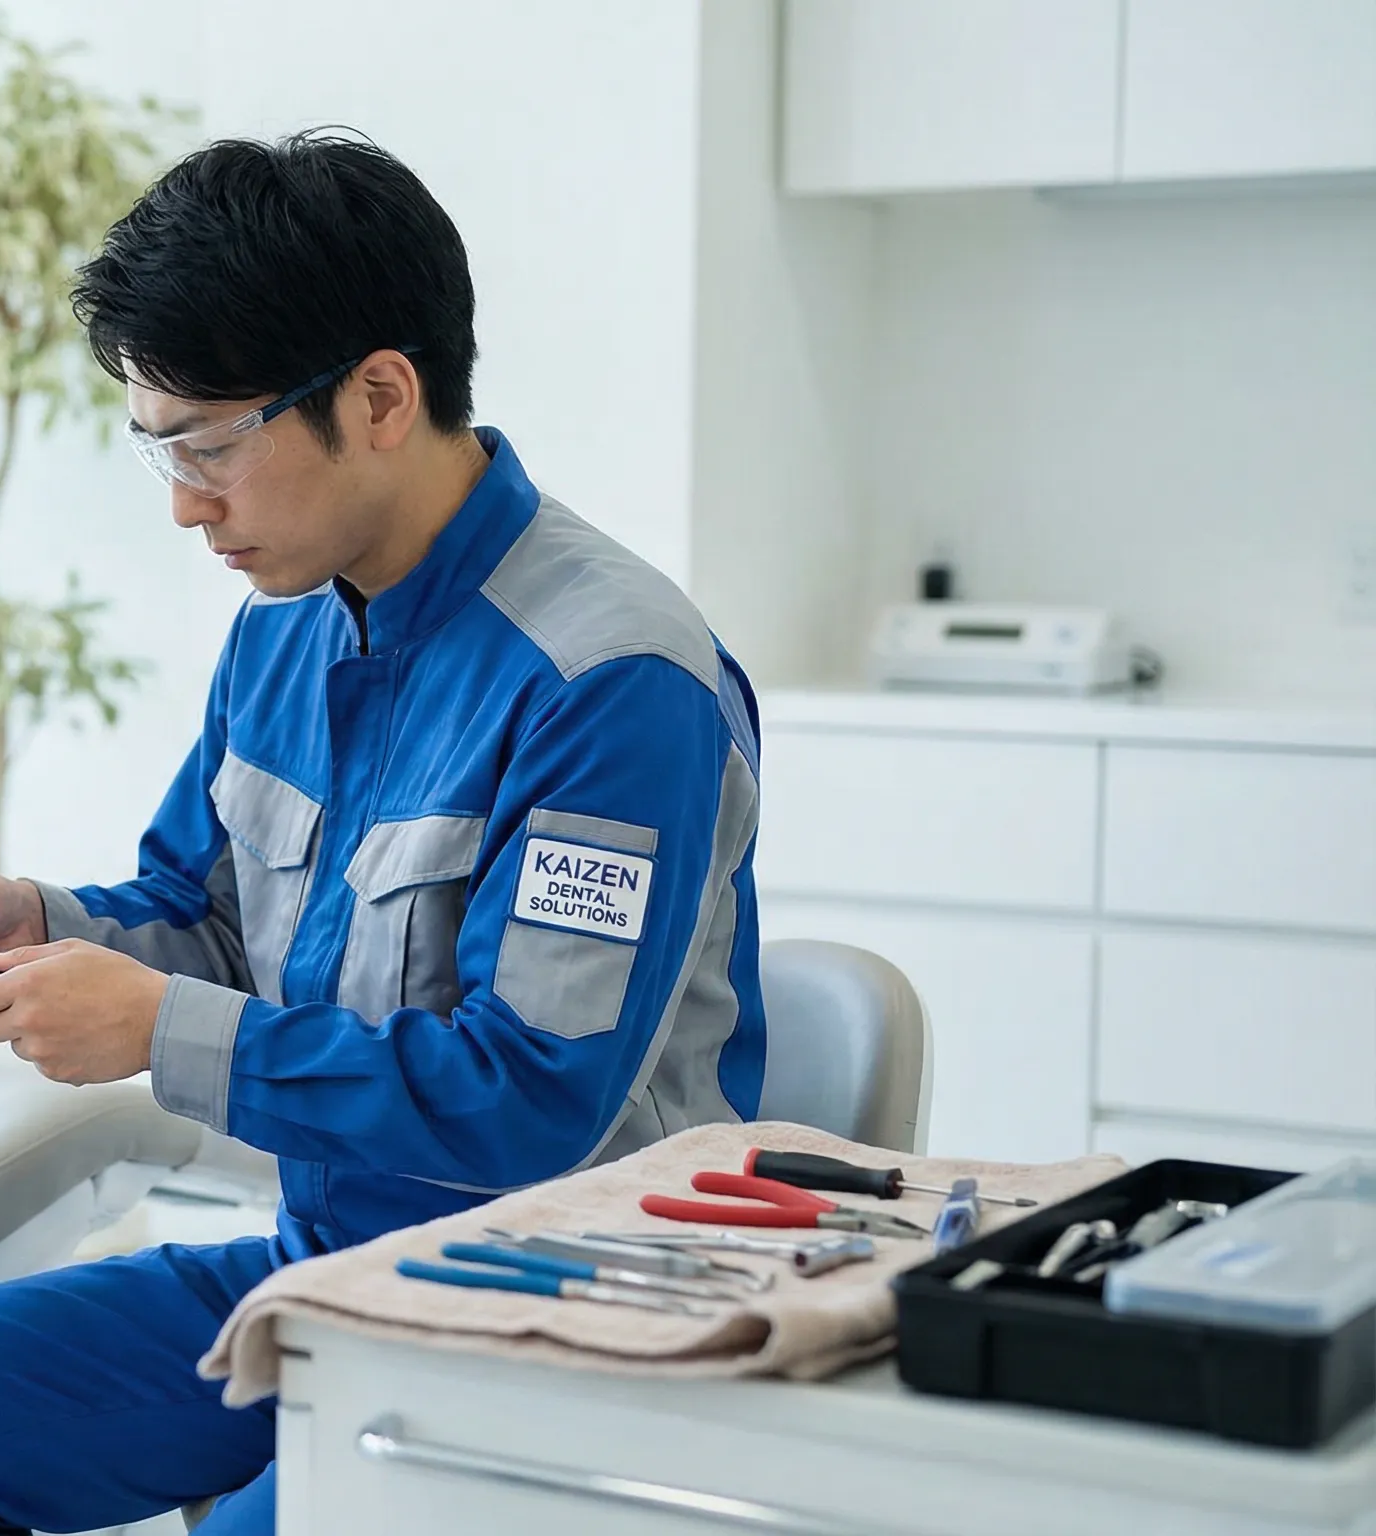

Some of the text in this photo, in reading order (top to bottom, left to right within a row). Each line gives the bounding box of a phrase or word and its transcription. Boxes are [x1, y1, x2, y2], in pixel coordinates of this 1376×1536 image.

[535, 851, 639, 891] KAIZEN
[547, 881, 615, 906] DENTAL
[529, 896, 628, 927] SOLUTIONS
